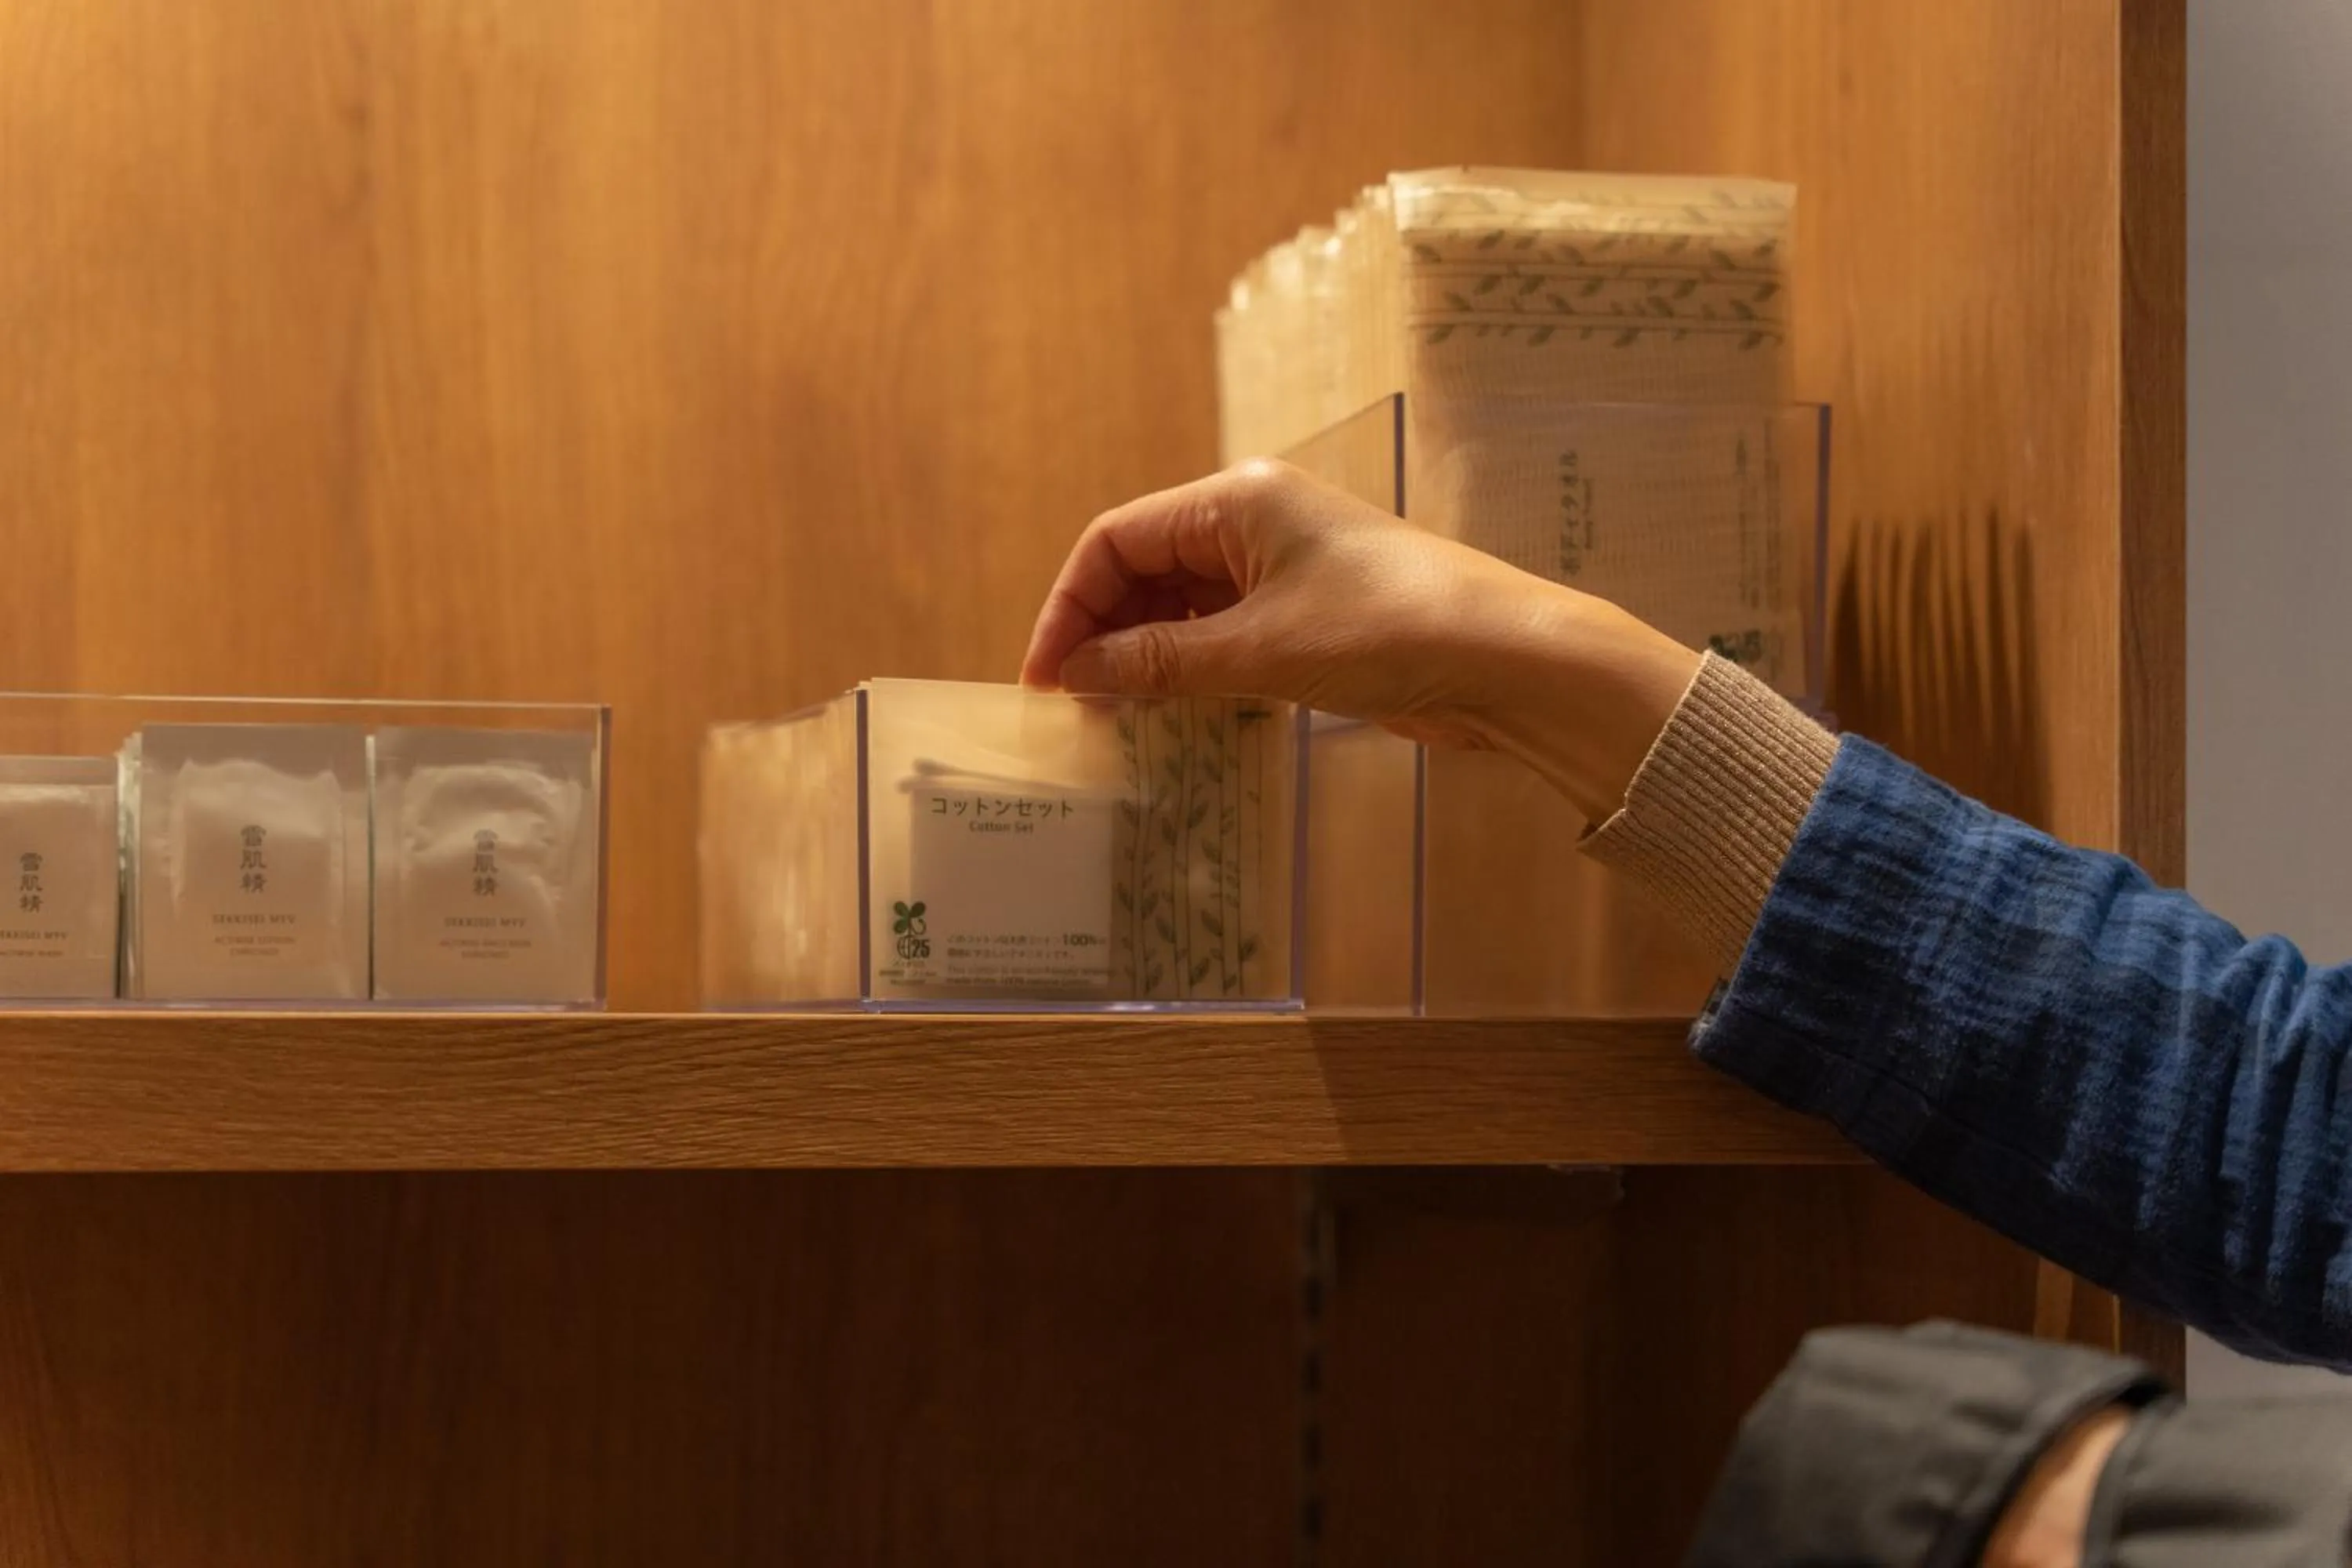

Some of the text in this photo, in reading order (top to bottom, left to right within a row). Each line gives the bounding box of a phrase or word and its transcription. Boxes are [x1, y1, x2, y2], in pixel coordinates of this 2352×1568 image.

[931, 797, 1073, 818] コットンセット
[241, 825, 267, 894] 雪肌精
[912, 938, 931, 958] 25
